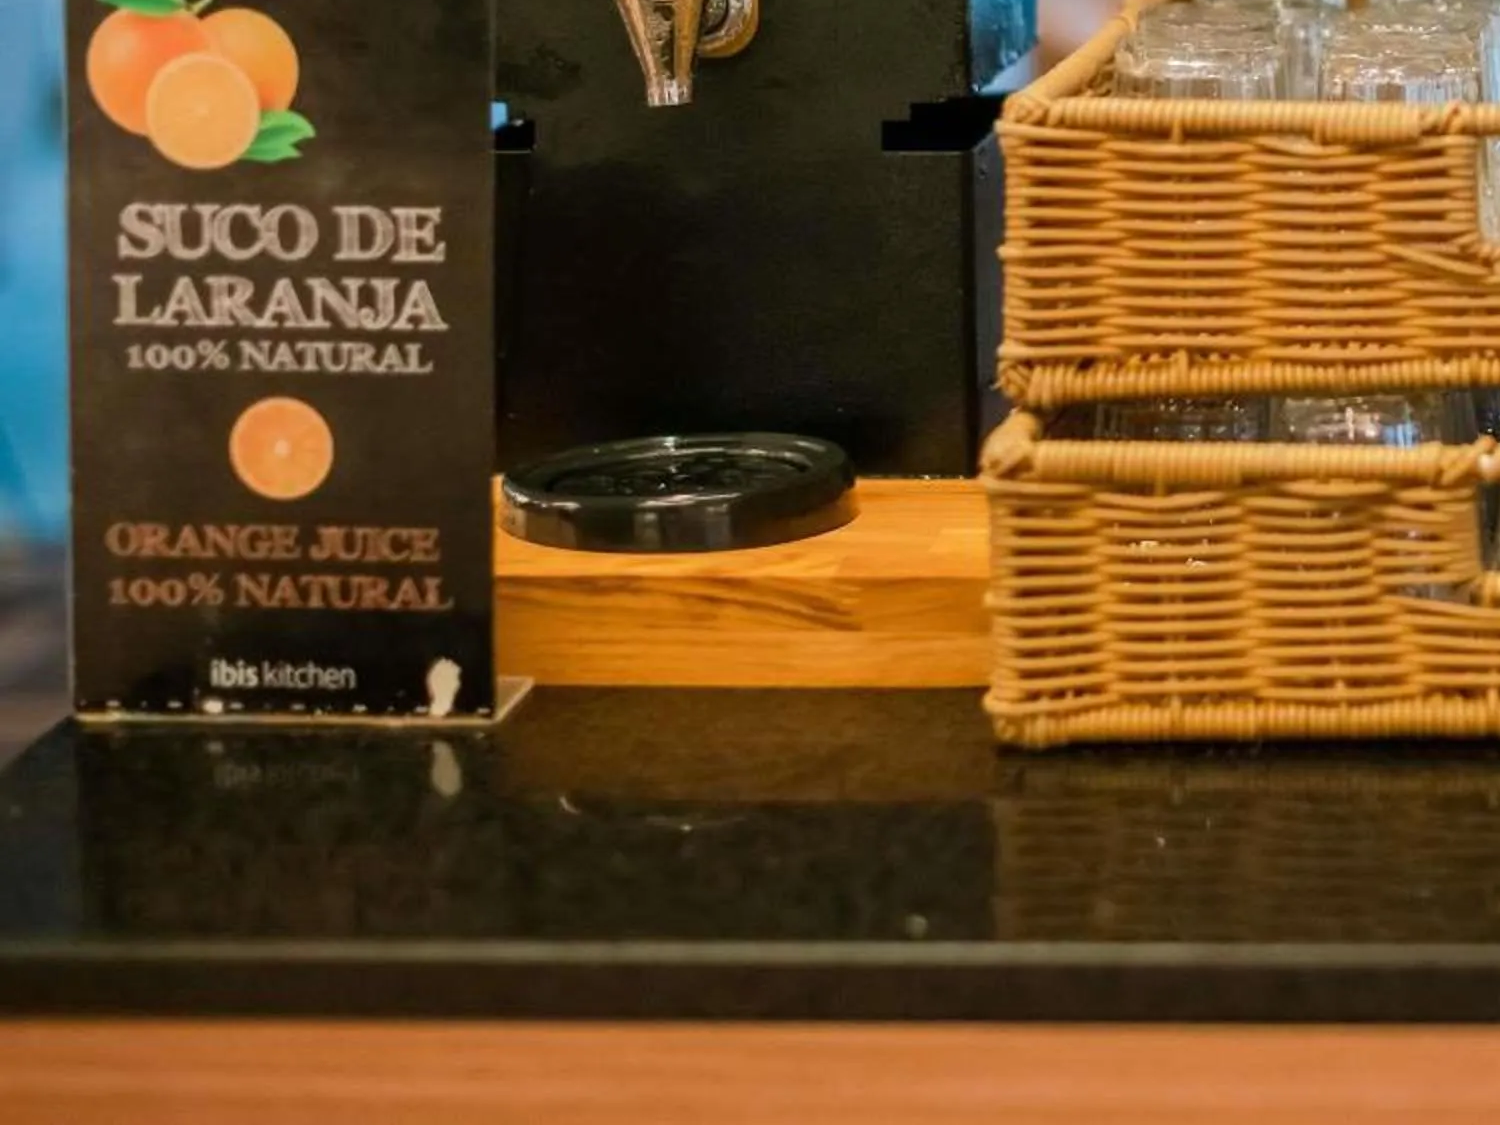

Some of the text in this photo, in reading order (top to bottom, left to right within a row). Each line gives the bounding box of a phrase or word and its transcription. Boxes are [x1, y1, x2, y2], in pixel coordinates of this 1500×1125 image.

[118, 203, 446, 262] SUCO DE
[112, 273, 449, 330] LARANJA
[126, 340, 434, 373] 100% NATURAL
[105, 522, 441, 562] ORANGE JUICE
[109, 573, 453, 610] 100% NATURAL
[210, 659, 356, 690] ibis kitchen
